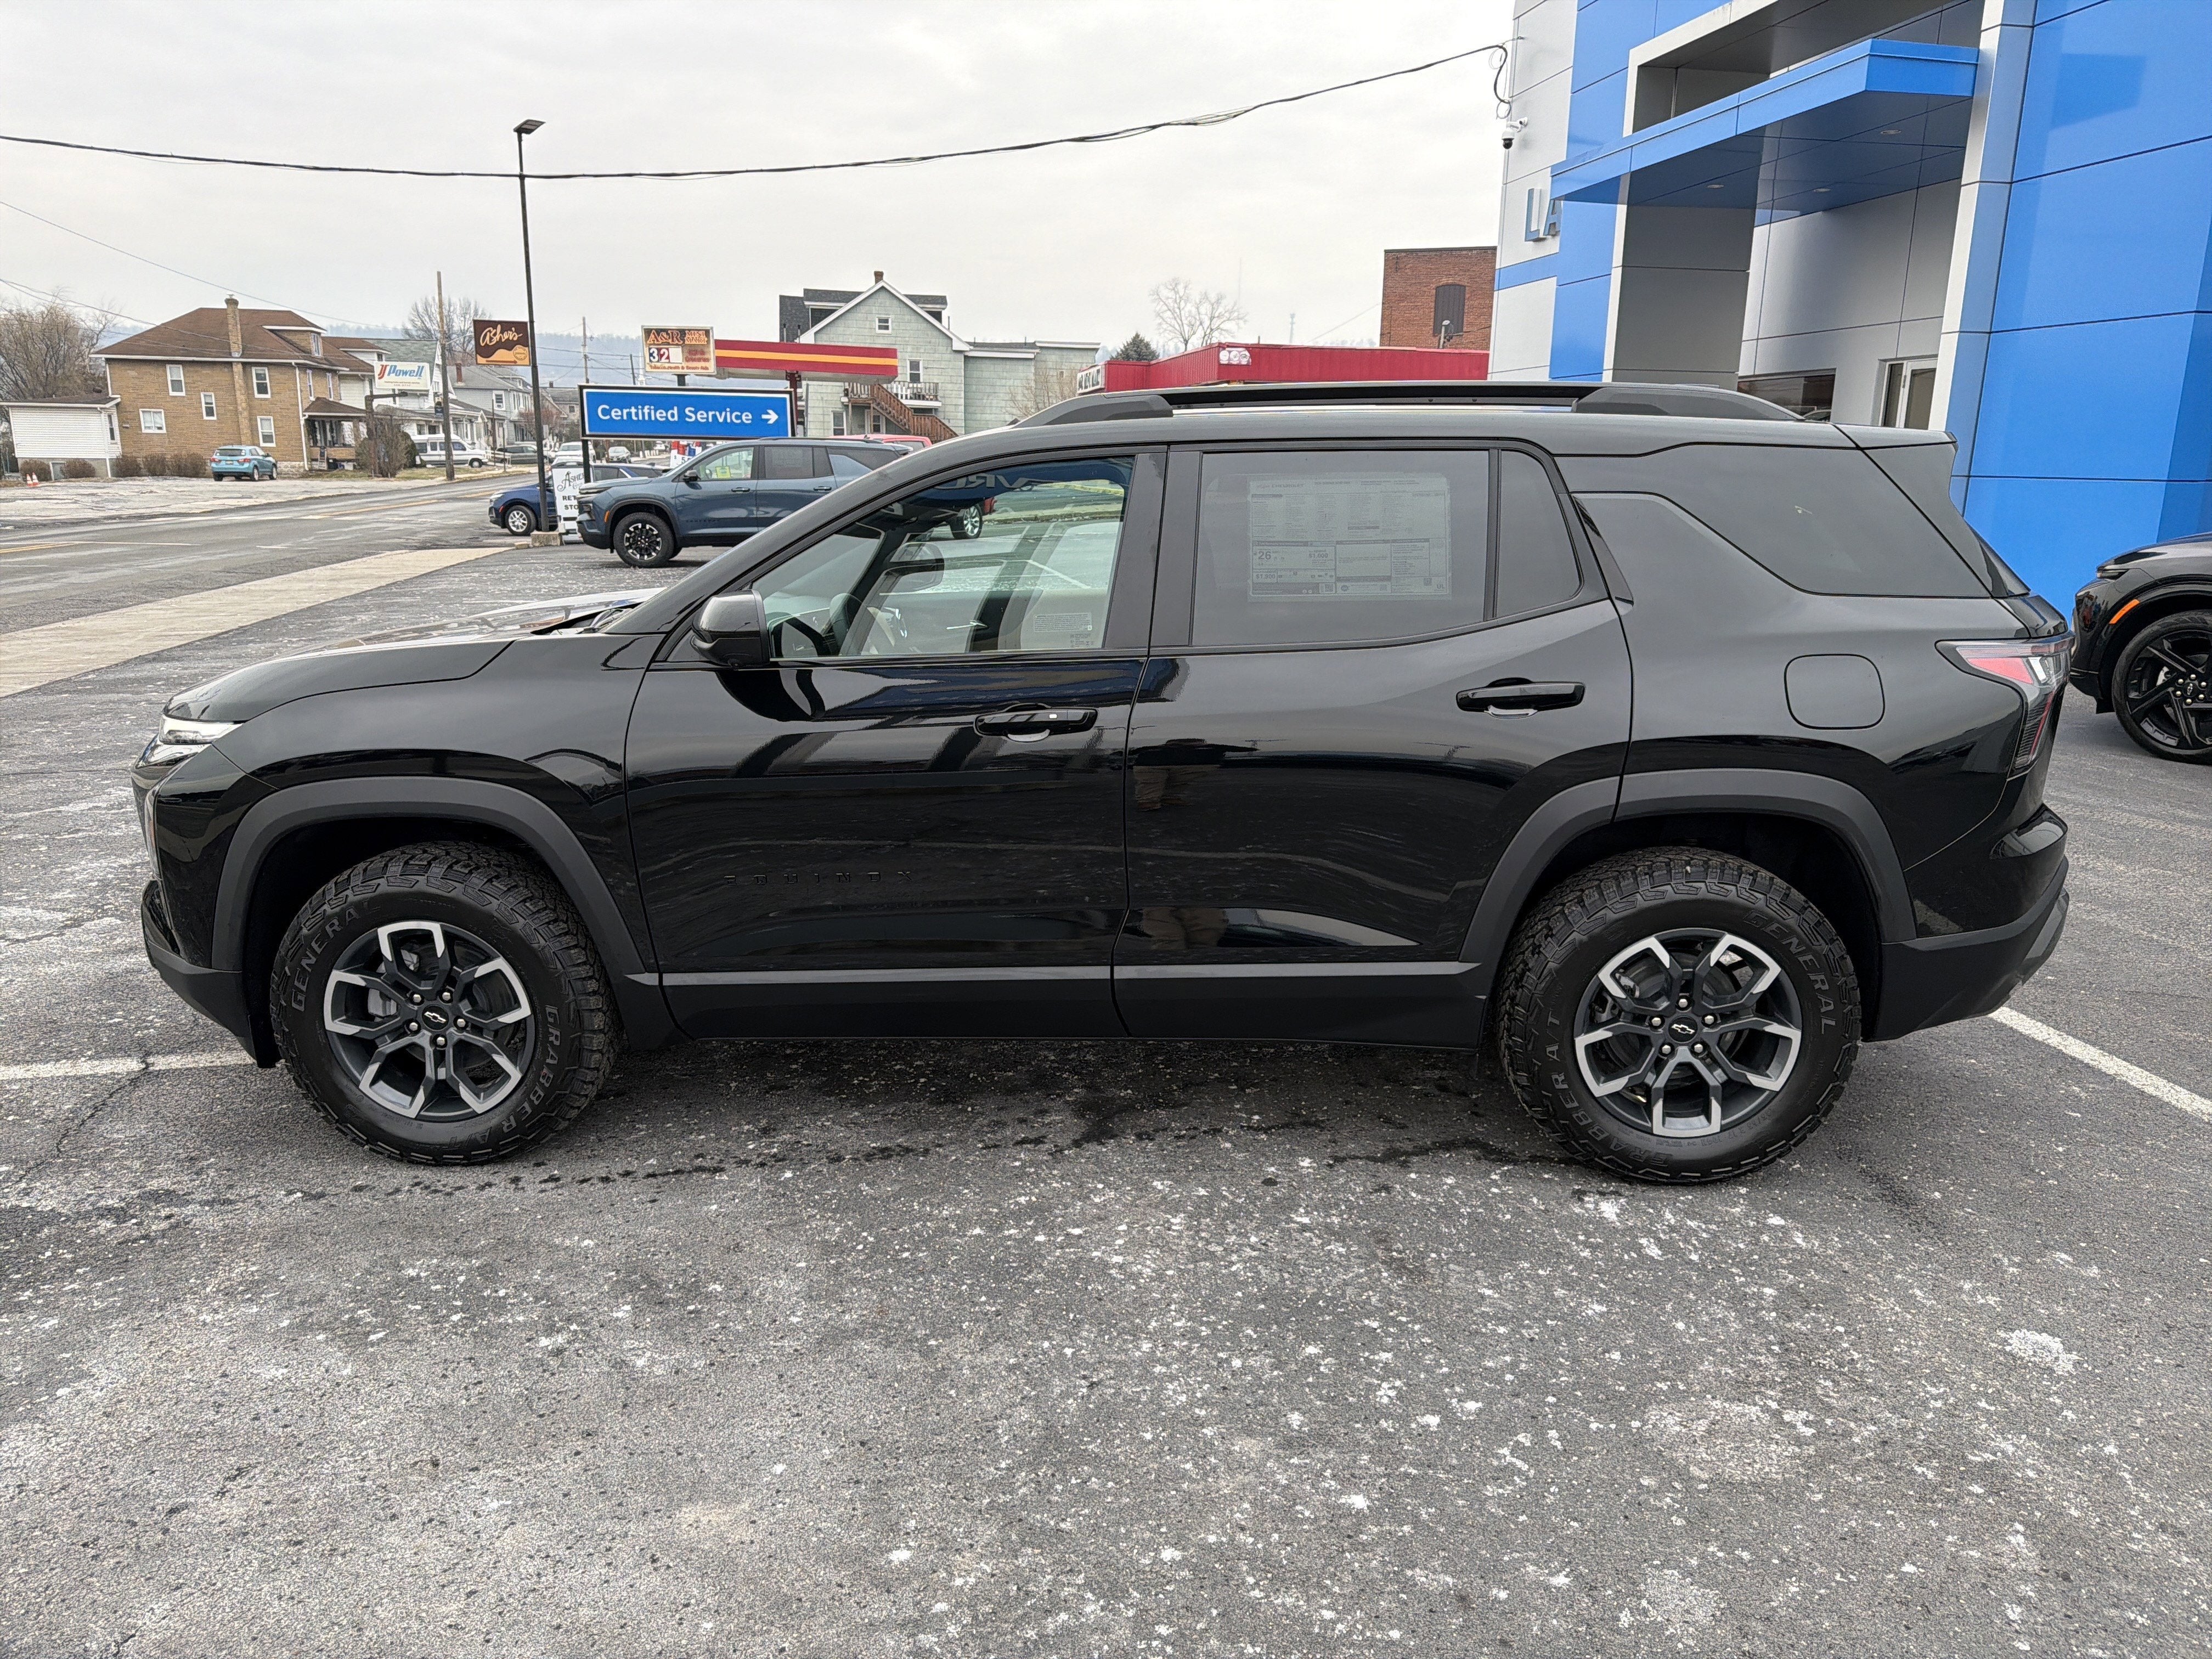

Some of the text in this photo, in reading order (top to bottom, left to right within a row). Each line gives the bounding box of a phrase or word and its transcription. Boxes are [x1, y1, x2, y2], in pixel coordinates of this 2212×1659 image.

[480, 324, 523, 346] Asher's
[647, 330, 682, 344] A&R
[387, 364, 425, 377] Powell
[597, 404, 753, 424] Certified Service
[1258, 550, 1272, 560] 26
[292, 899, 381, 1012] GENERAL
[1742, 909, 1836, 1035] GENERAL
[1545, 1008, 1561, 1062] A/T
[501, 1005, 562, 1134] GRABBER
[1551, 1073, 1673, 1167] GRABBER
